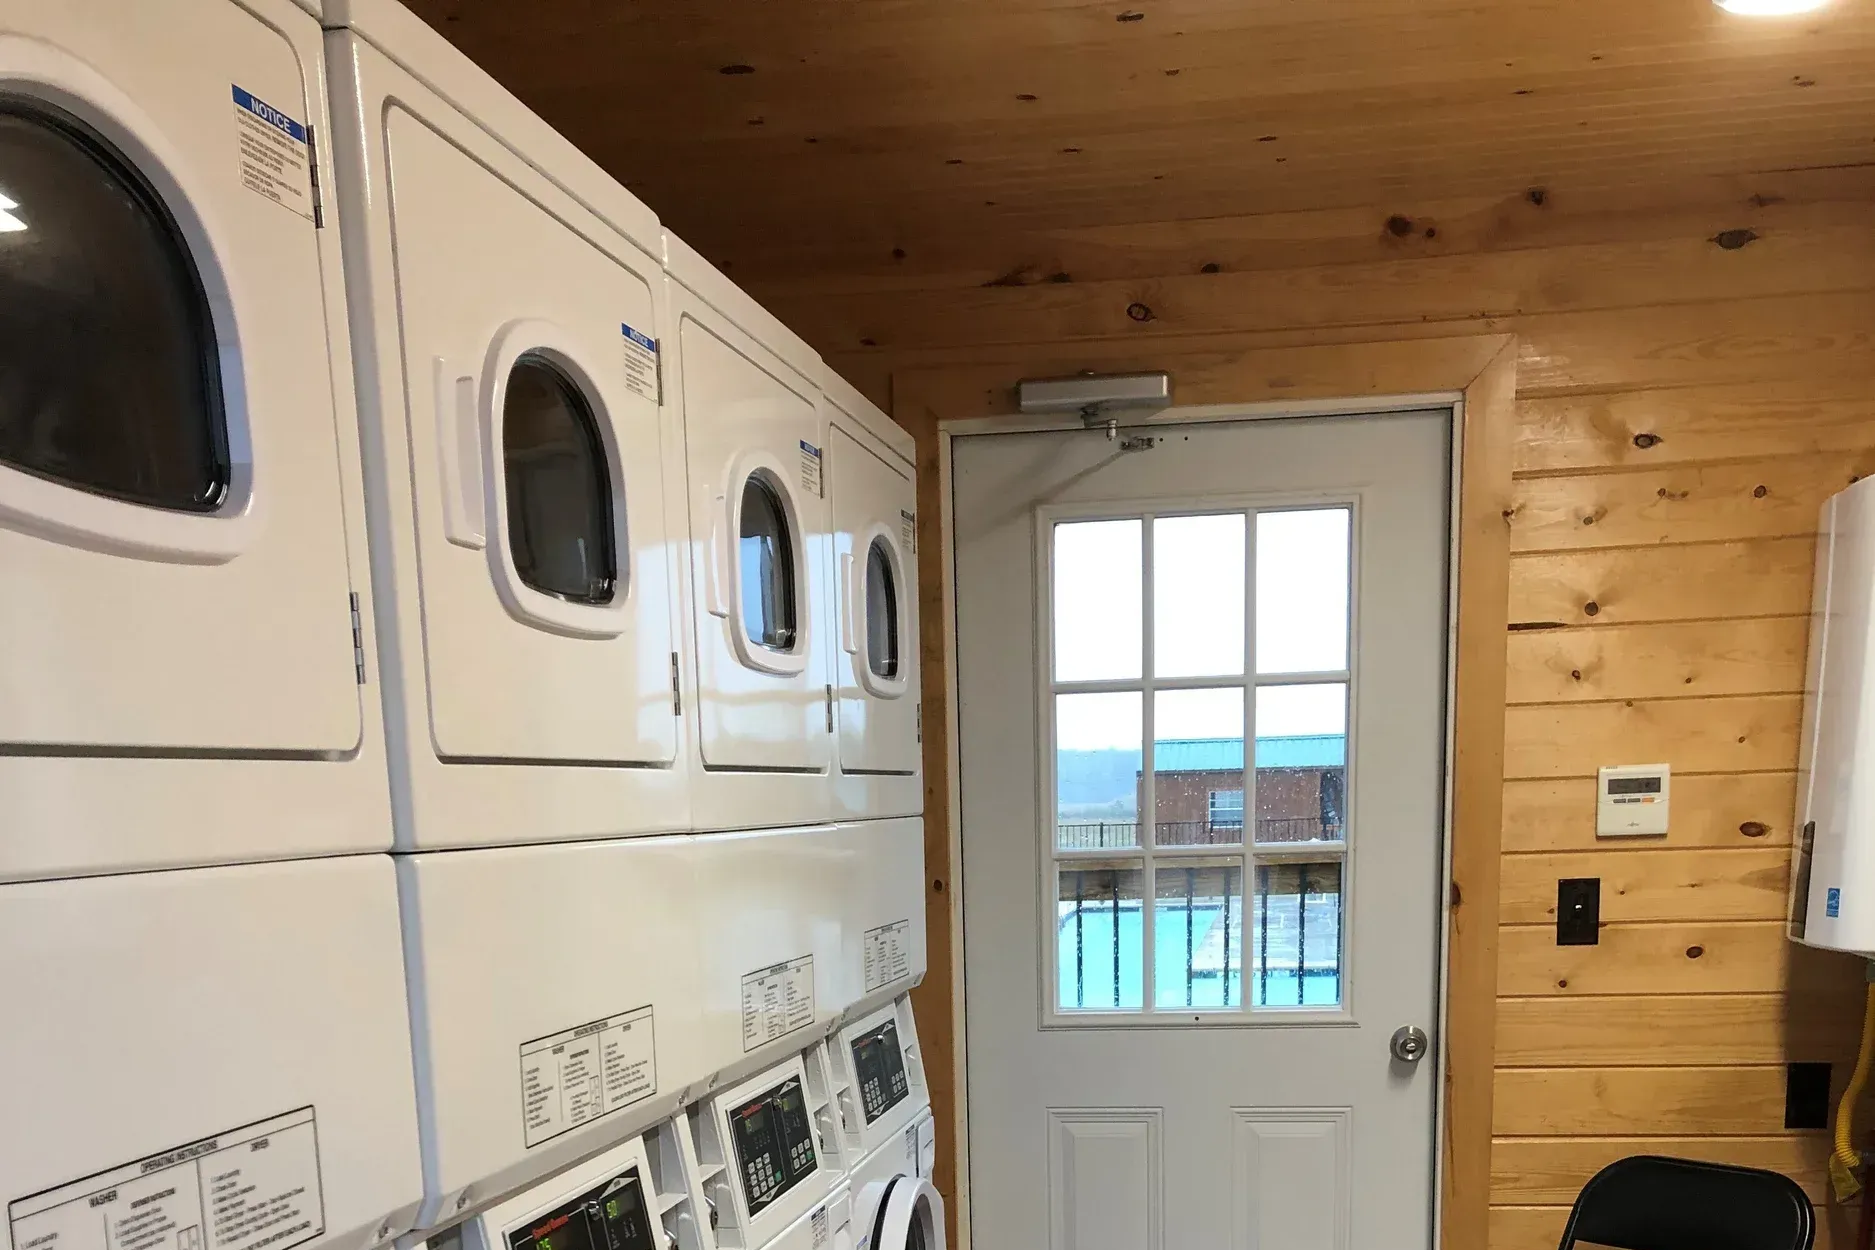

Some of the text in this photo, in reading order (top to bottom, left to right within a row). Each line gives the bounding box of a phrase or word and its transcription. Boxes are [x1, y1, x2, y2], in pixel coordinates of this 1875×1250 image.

[251, 97, 291, 133] NOTICE
[140, 1139, 218, 1174] OPERATING INSTRUCTIONS
[88, 1190, 119, 1208] WASHER
